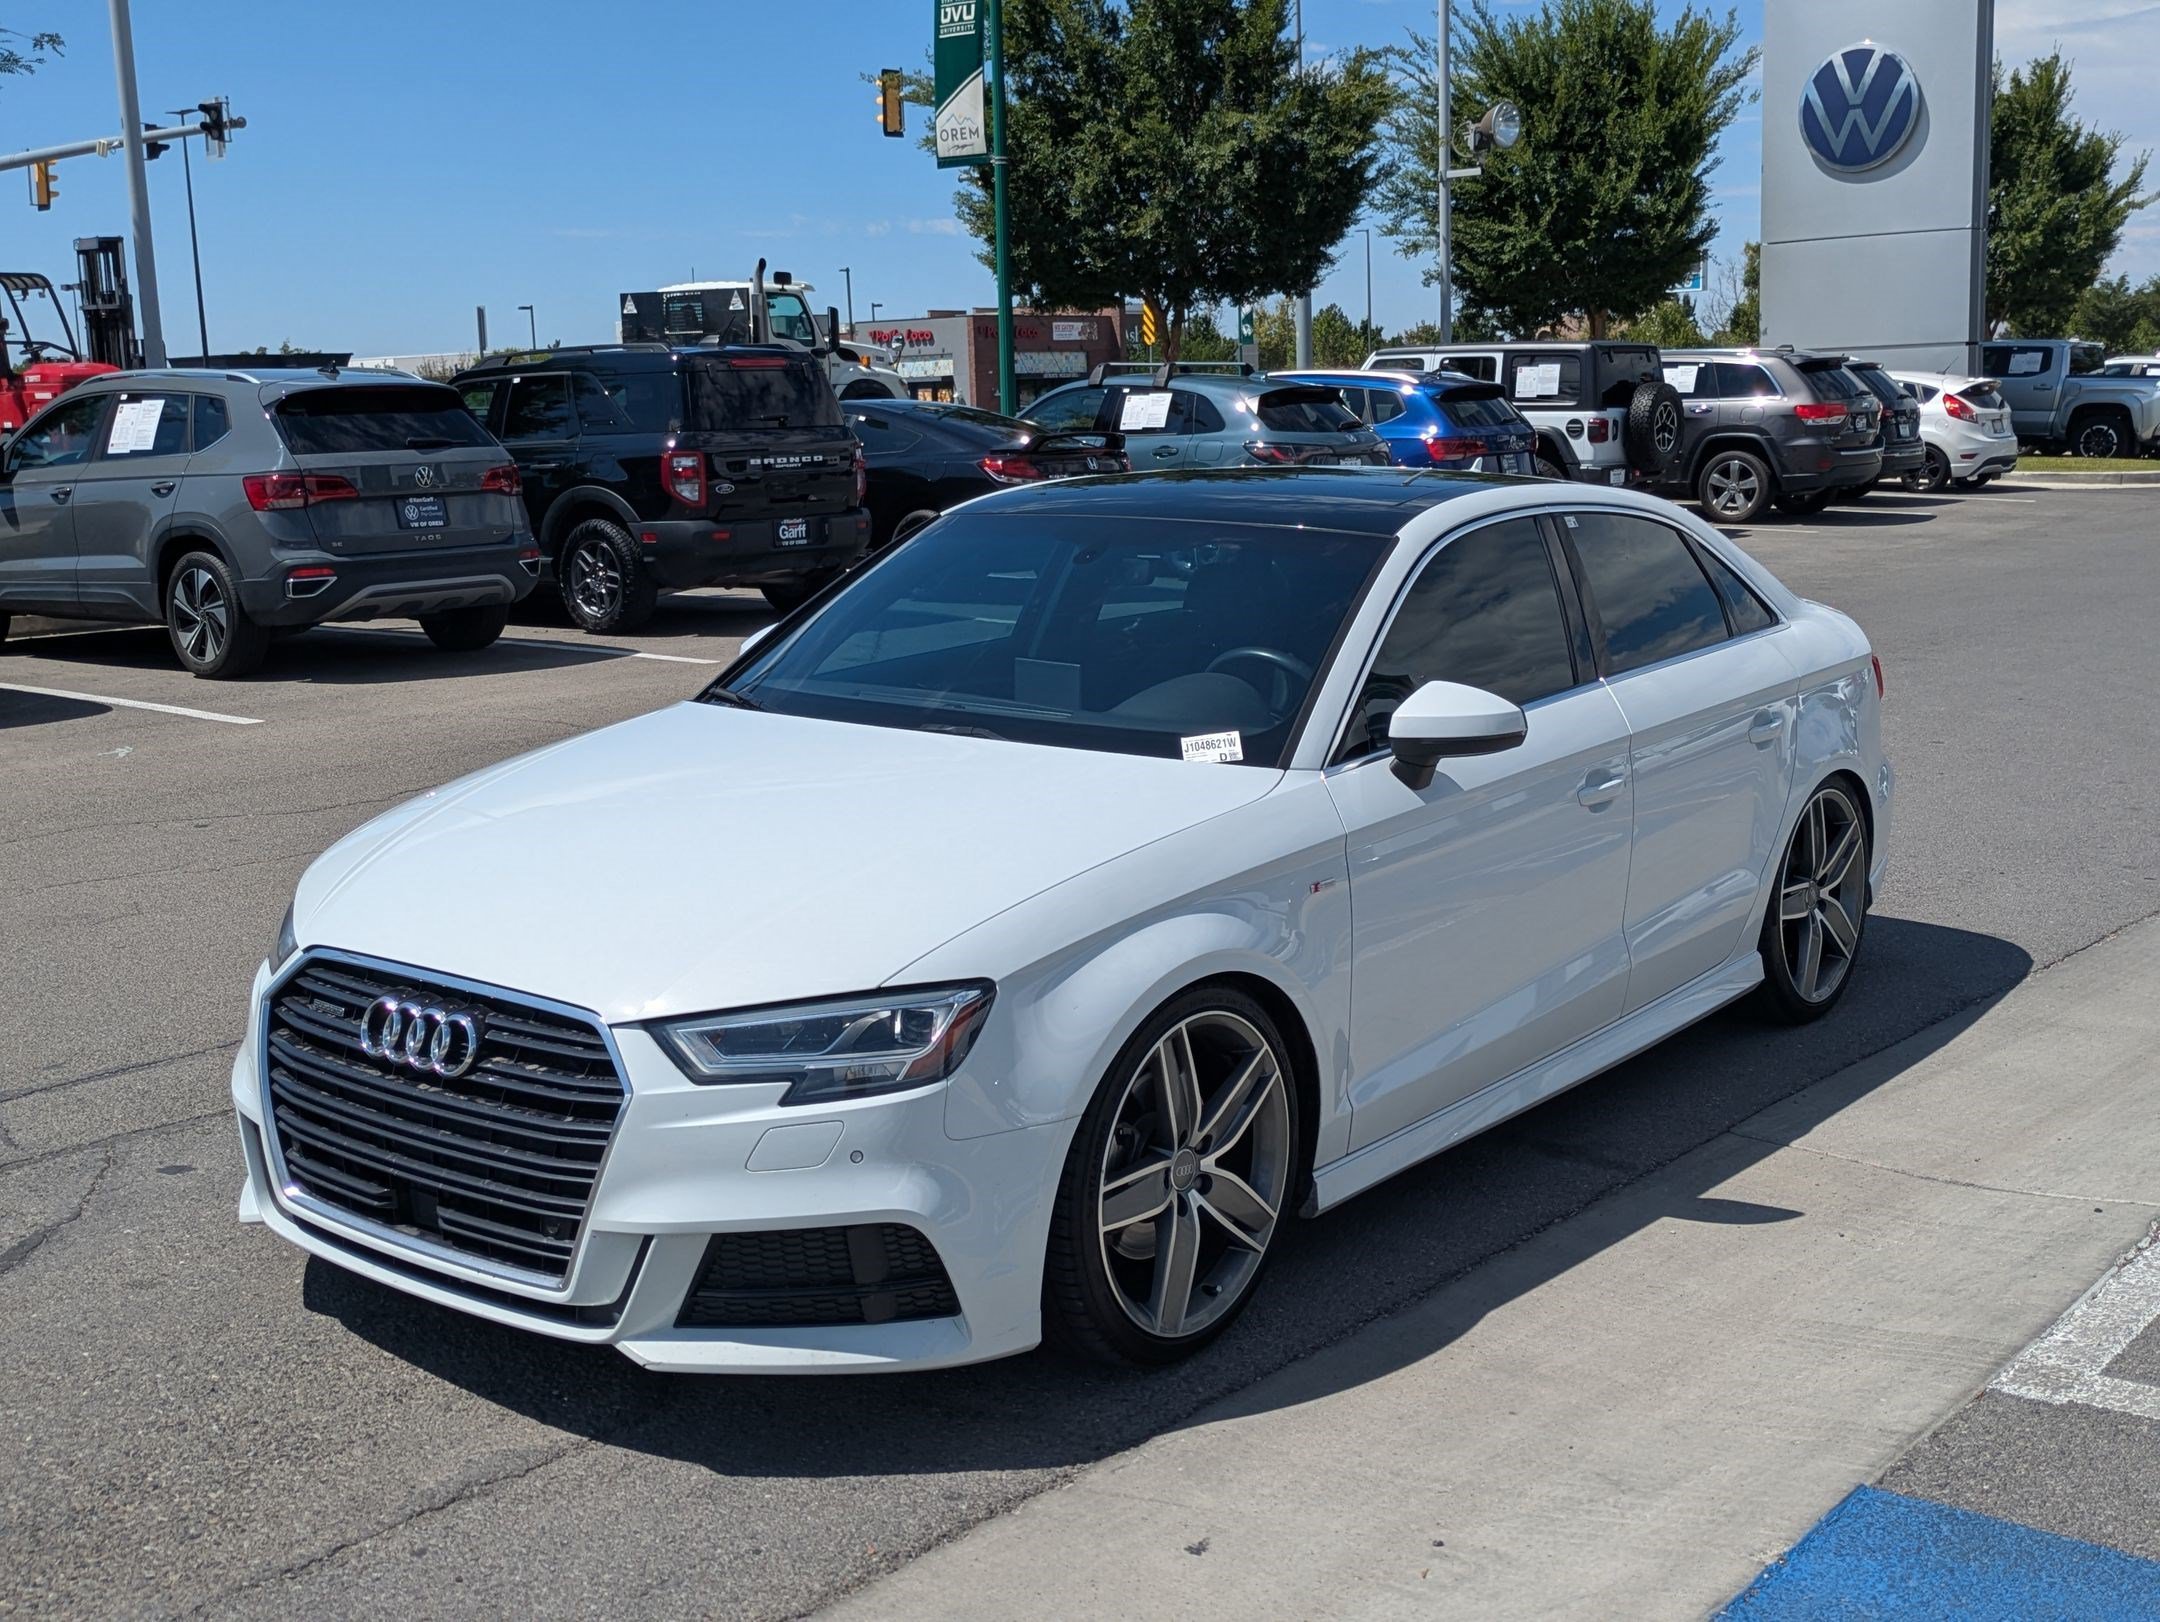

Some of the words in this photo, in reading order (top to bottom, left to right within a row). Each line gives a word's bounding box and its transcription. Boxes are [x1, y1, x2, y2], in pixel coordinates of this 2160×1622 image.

[941, 4, 975, 24] UVU
[940, 24, 975, 34] UNIVERSITY
[940, 126, 979, 142] OREM
[905, 328, 932, 342] Loco
[750, 455, 823, 465] BRONCO
[779, 524, 806, 539] Garff
[1184, 737, 1237, 753] J1048621W
[1220, 753, 1228, 761] D
